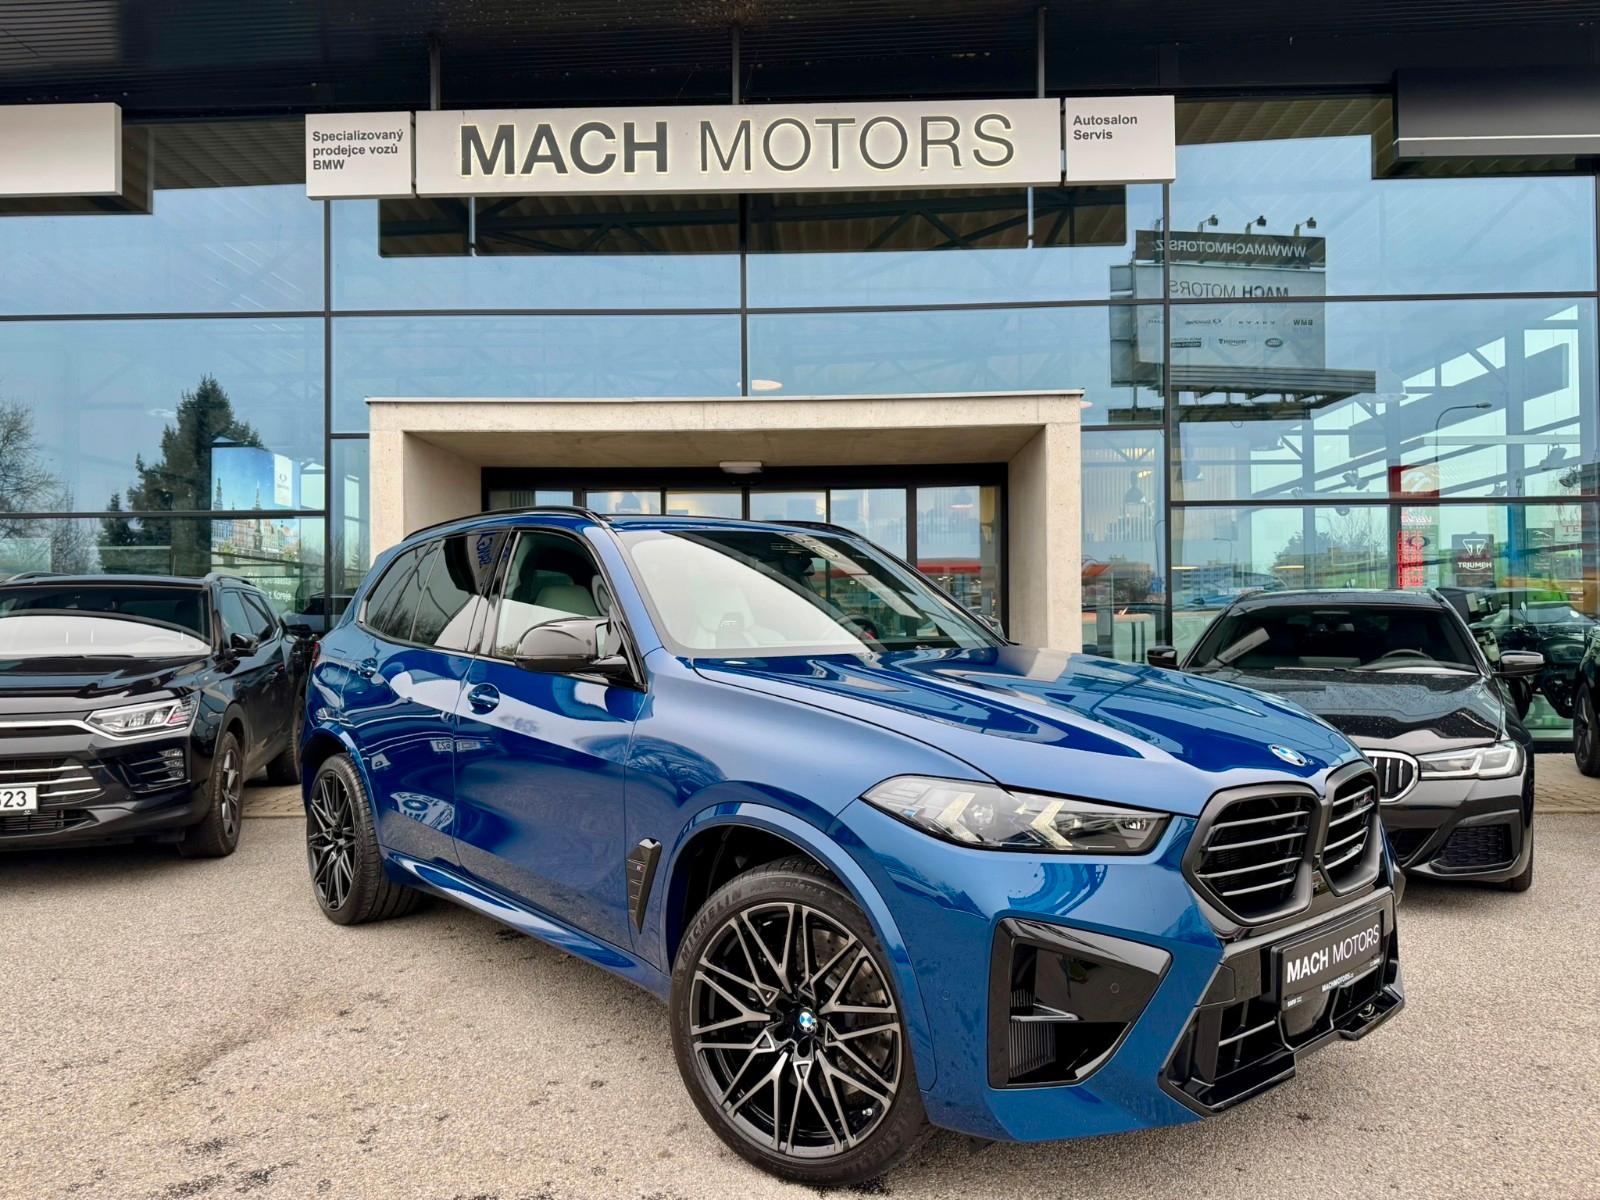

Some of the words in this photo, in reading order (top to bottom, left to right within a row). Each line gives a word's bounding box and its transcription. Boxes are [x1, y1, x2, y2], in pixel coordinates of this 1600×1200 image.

[1073, 113, 1138, 126] Autosalon
[312, 127, 404, 143] Specializovaný
[1073, 127, 1113, 141] Servis
[312, 143, 366, 158] prodejce
[369, 142, 398, 156] vozů
[460, 120, 668, 176] MACH
[699, 113, 1015, 173] MOTORS
[312, 158, 345, 170] BMW
[1457, 561, 1492, 570] TRIUMPH
[1286, 947, 1329, 984] MACH
[1332, 924, 1379, 965] MOTORS
